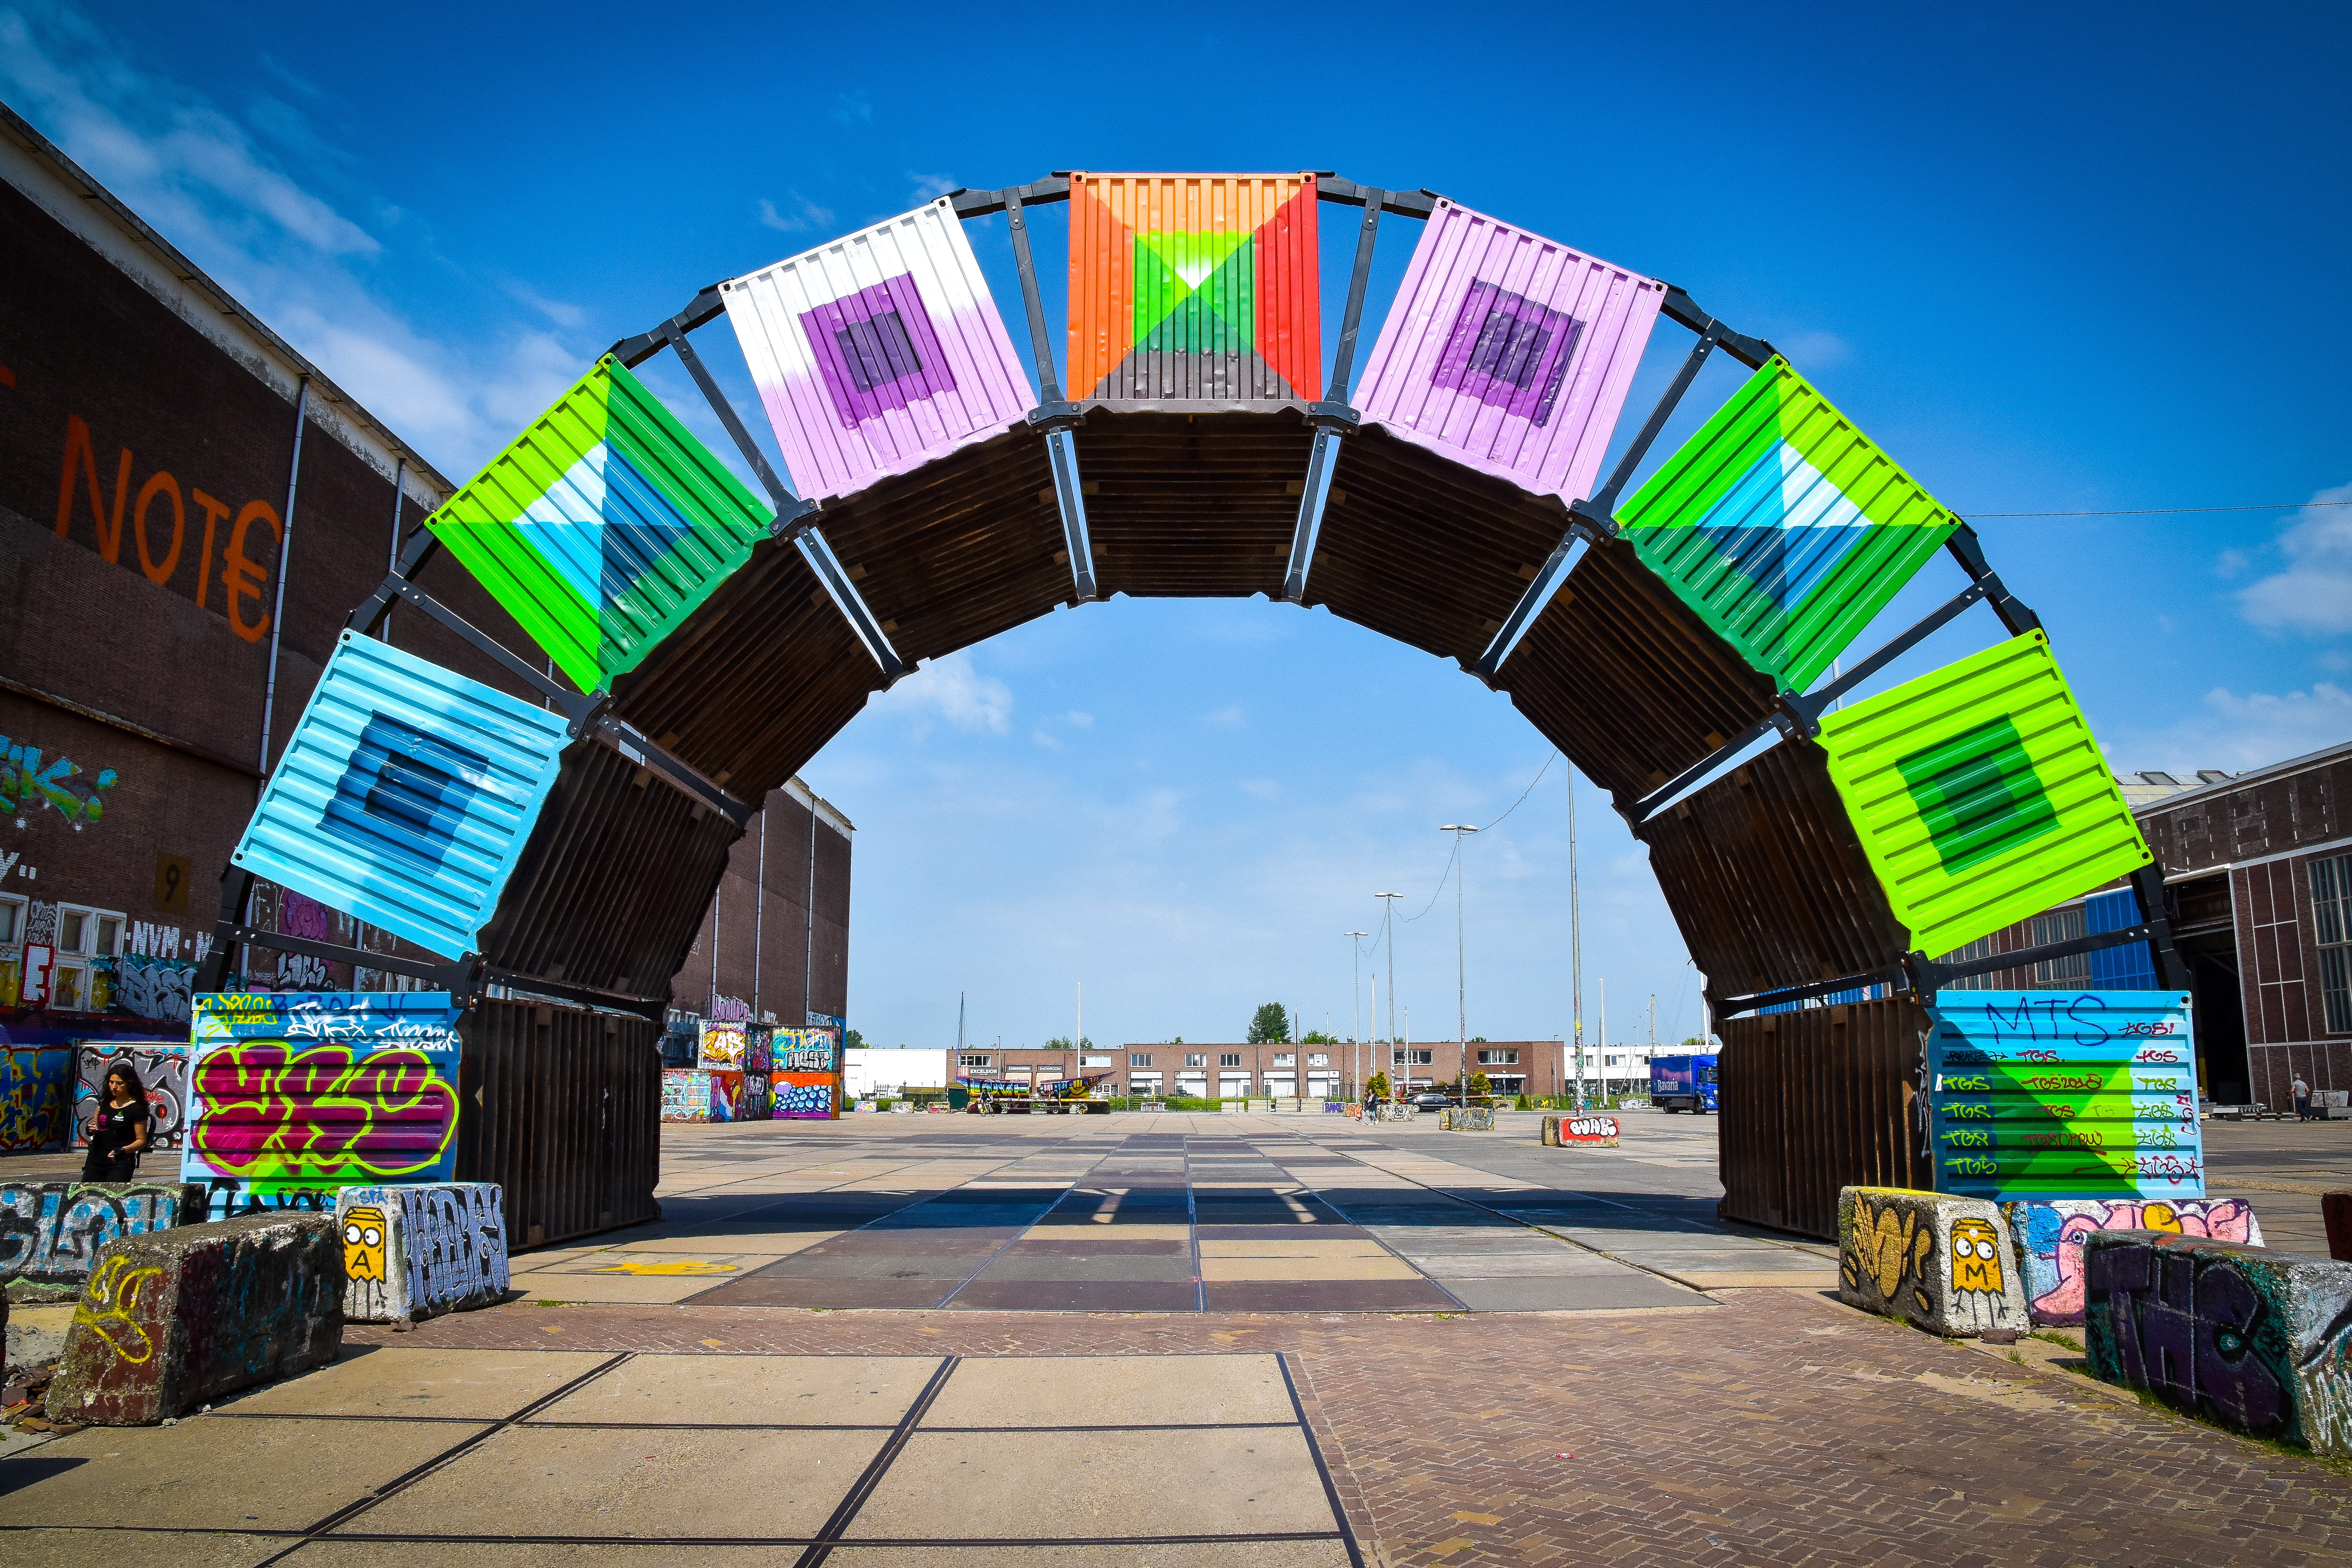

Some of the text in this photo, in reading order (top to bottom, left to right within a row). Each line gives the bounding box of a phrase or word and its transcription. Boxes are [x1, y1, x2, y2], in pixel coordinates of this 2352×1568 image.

[163, 863, 180, 903] 9
[1985, 994, 2110, 1047] MTS
[968, 1078, 1030, 1097] LOVE
[1657, 1078, 1678, 1092] Bavaria
